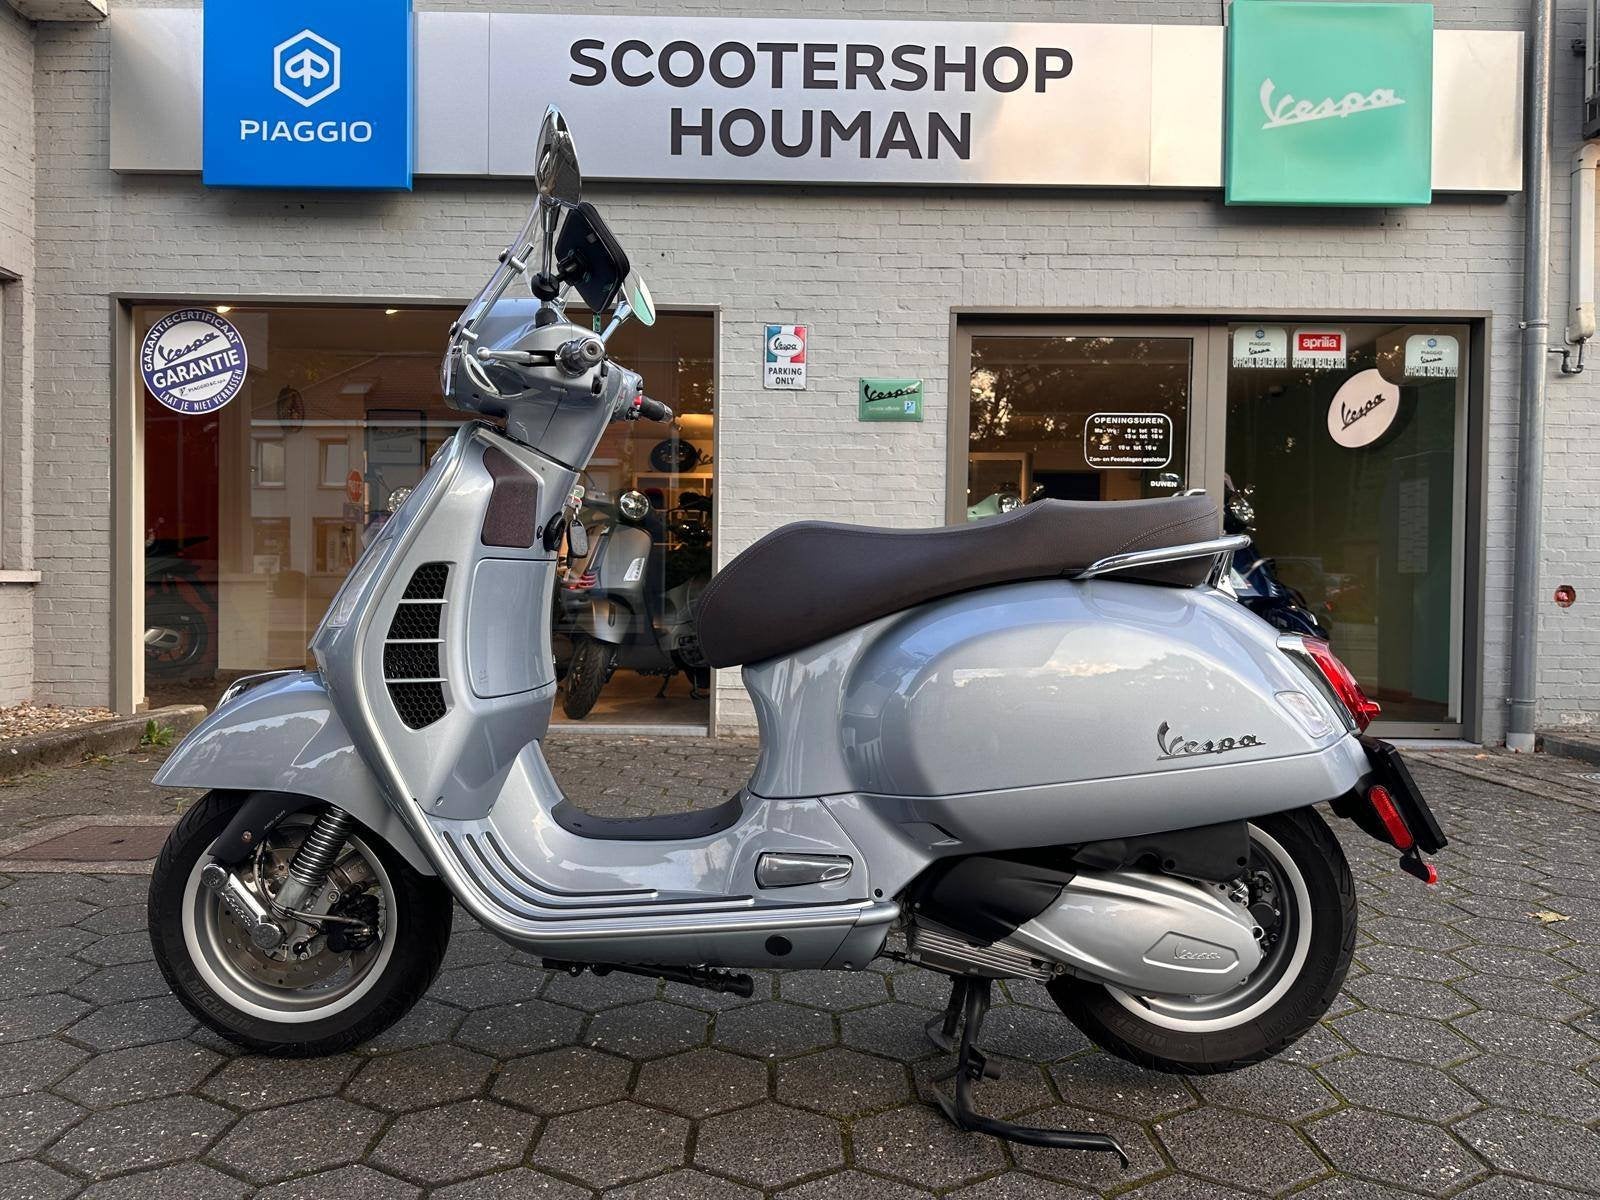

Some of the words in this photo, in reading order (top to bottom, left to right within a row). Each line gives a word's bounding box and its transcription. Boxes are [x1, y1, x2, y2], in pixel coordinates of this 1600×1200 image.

[569, 38, 1073, 93] SCOOTERSHOP
[1260, 78, 1406, 129] Vespa
[239, 119, 373, 143] PIAGGIO
[671, 108, 971, 160] HOUMAN
[144, 310, 240, 372] GARANTIECERTIFICAAT
[158, 332, 220, 366] Vespa
[774, 337, 799, 351] Vespa
[1302, 336, 1337, 350] aprilia
[152, 349, 241, 389] GARANTIE
[768, 367, 803, 376] PARKING
[1233, 357, 1254, 368] OFFICIAL
[1256, 357, 1274, 368] DEALER
[1293, 357, 1313, 368] OFFICIAL
[1315, 357, 1333, 368] DEALER
[1405, 366, 1426, 377] OFFICIAL
[1427, 366, 1445, 377] DEALER
[159, 390, 179, 407] LAAT
[180, 402, 188, 411] JE
[194, 400, 212, 411] NIET
[212, 369, 244, 405] VERRASSEN
[775, 377, 795, 385] ONLY
[864, 383, 920, 403] Vespa
[1341, 394, 1386, 431] Vespa
[1150, 480, 1178, 488] DUWEN
[1156, 720, 1266, 761] Vespa
